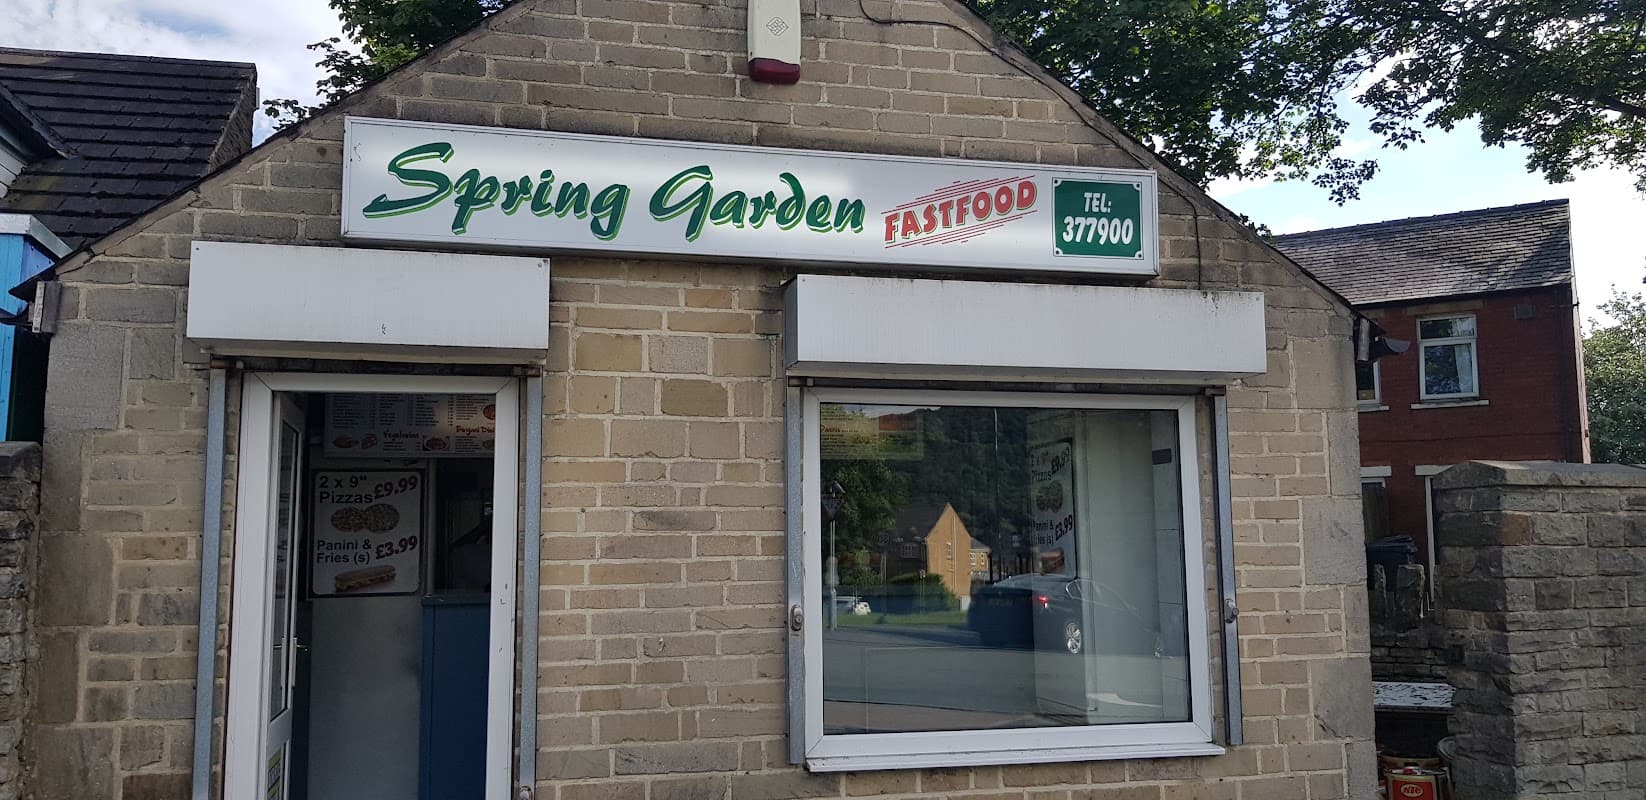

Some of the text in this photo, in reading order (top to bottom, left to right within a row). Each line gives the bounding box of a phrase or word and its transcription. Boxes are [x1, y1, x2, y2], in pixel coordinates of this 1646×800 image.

[362, 142, 866, 242] Spring Garden
[1083, 192, 1111, 214] TEL:
[884, 180, 1038, 244] FASTFOOD
[1062, 215, 1135, 246] 377900
[319, 475, 367, 489] 2 x 9"
[374, 475, 418, 499] £9.99
[319, 491, 374, 504] Pizzas
[1054, 514, 1073, 541] £3.99
[317, 539, 372, 551] Panini &
[375, 535, 418, 561] £3.99
[316, 552, 370, 565] Fries (s)
